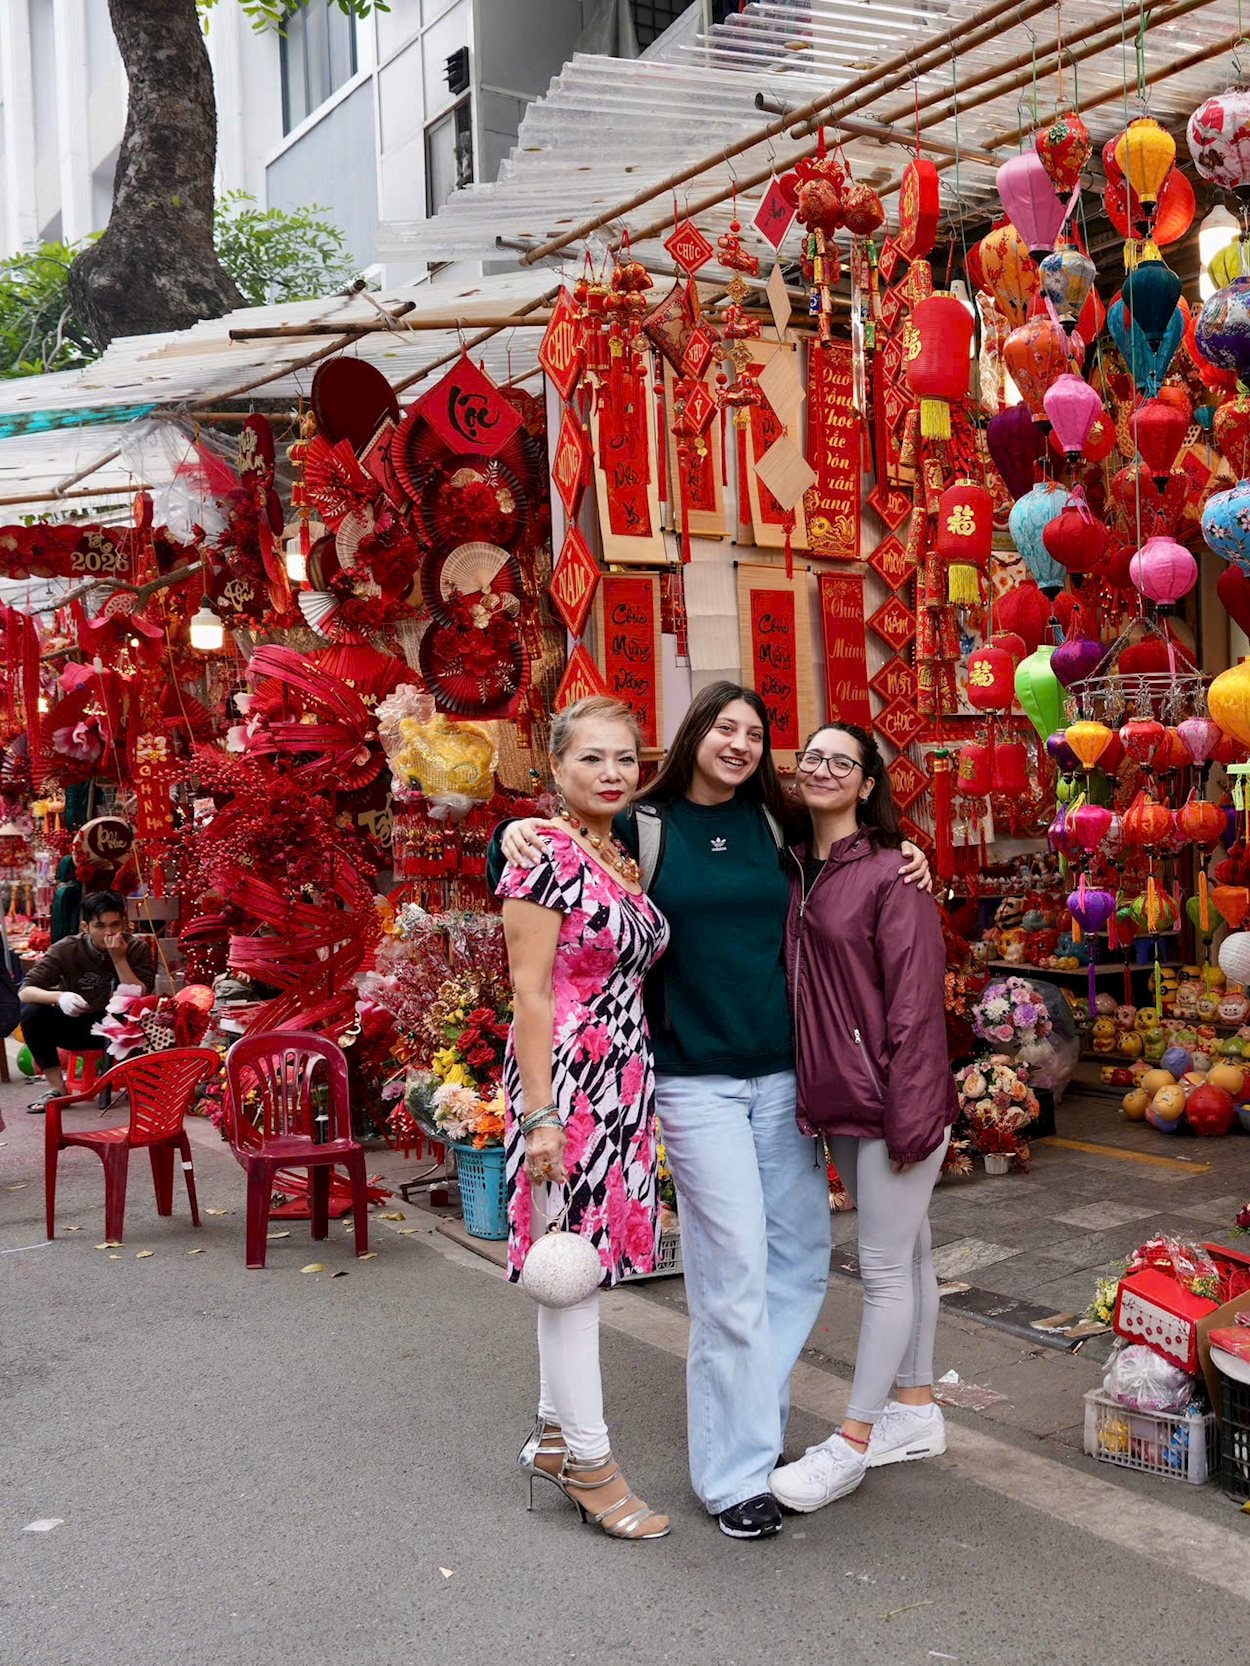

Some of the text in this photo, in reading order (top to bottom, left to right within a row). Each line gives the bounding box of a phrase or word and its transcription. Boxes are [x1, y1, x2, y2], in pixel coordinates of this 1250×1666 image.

[676, 242, 702, 261] CHÚC
[820, 387, 855, 407] ồng
[448, 385, 499, 445] Lộc
[820, 407, 855, 429] hoe
[822, 428, 847, 448] ắc
[946, 504, 976, 537] 福
[70, 551, 130, 573] 2026
[969, 660, 995, 688] 福
[885, 708, 916, 733] CHÚC
